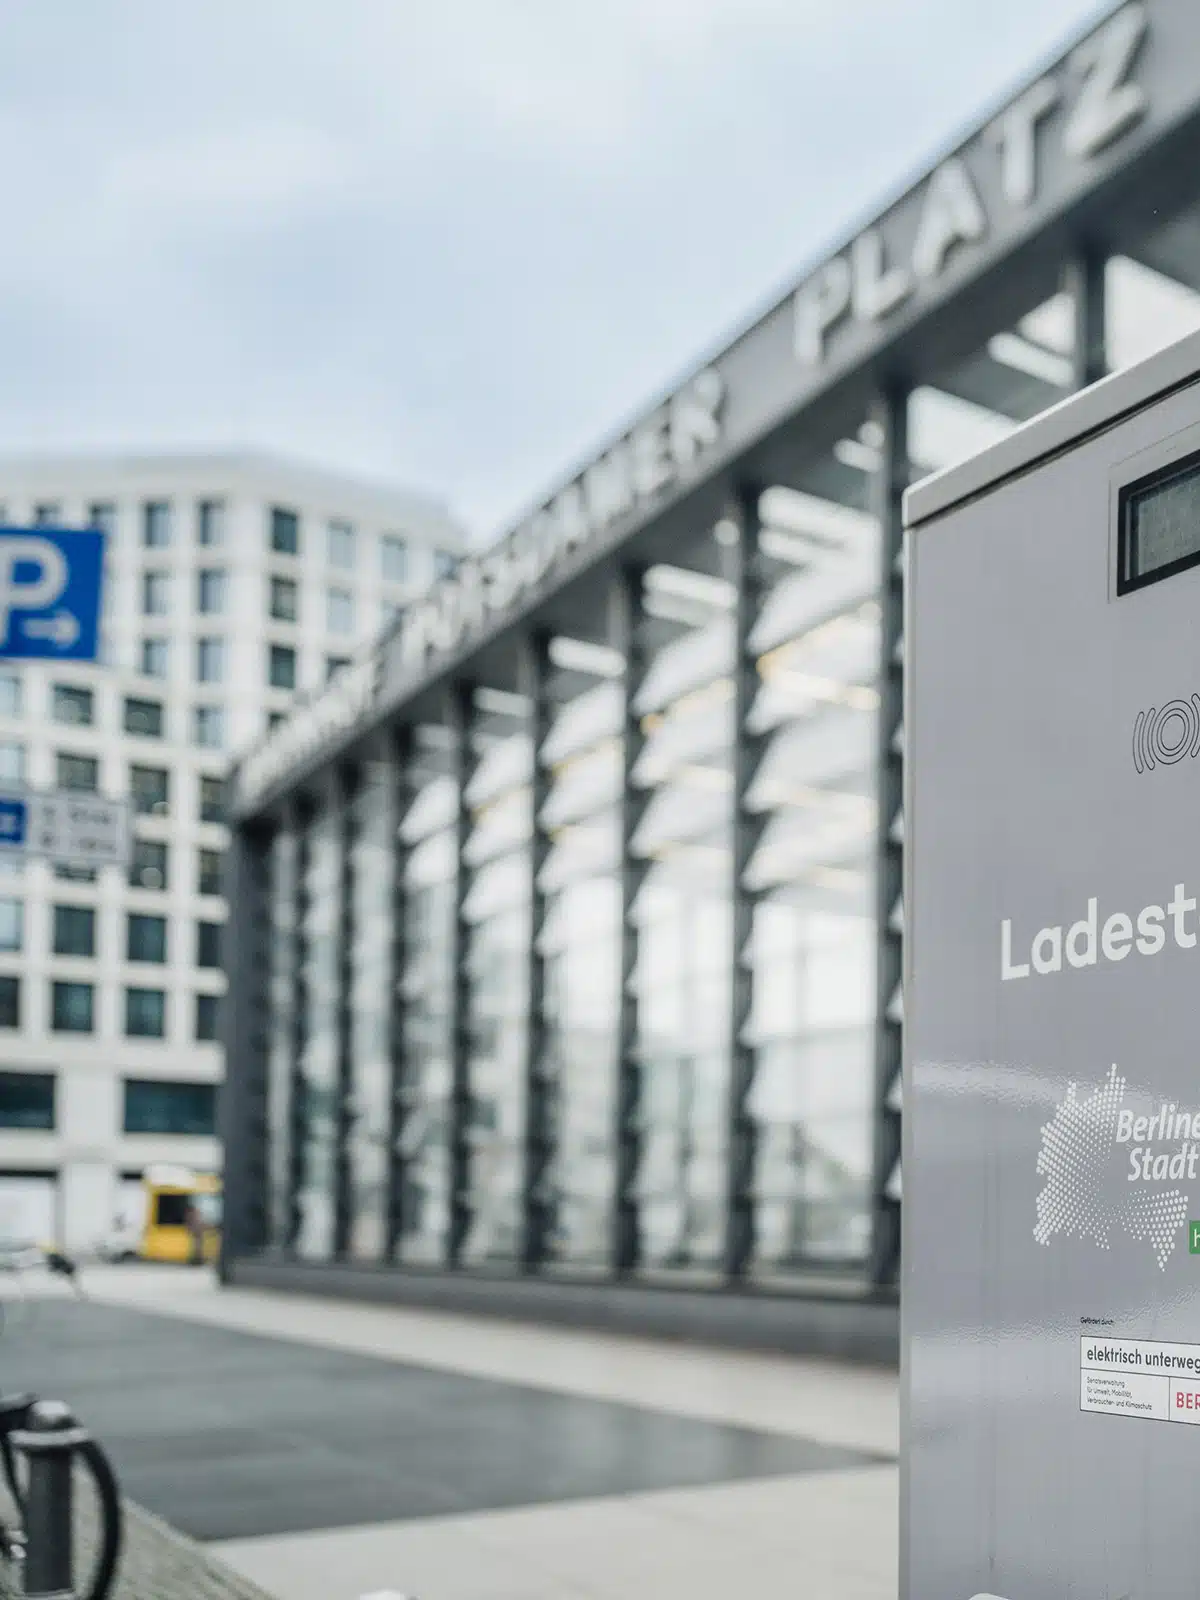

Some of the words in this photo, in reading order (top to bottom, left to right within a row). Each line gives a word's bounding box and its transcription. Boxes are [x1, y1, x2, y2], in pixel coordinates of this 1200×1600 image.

[792, 0, 1147, 365] PLATZ
[0, 533, 69, 648] P
[1086, 1345, 1142, 1365] elektrisch
